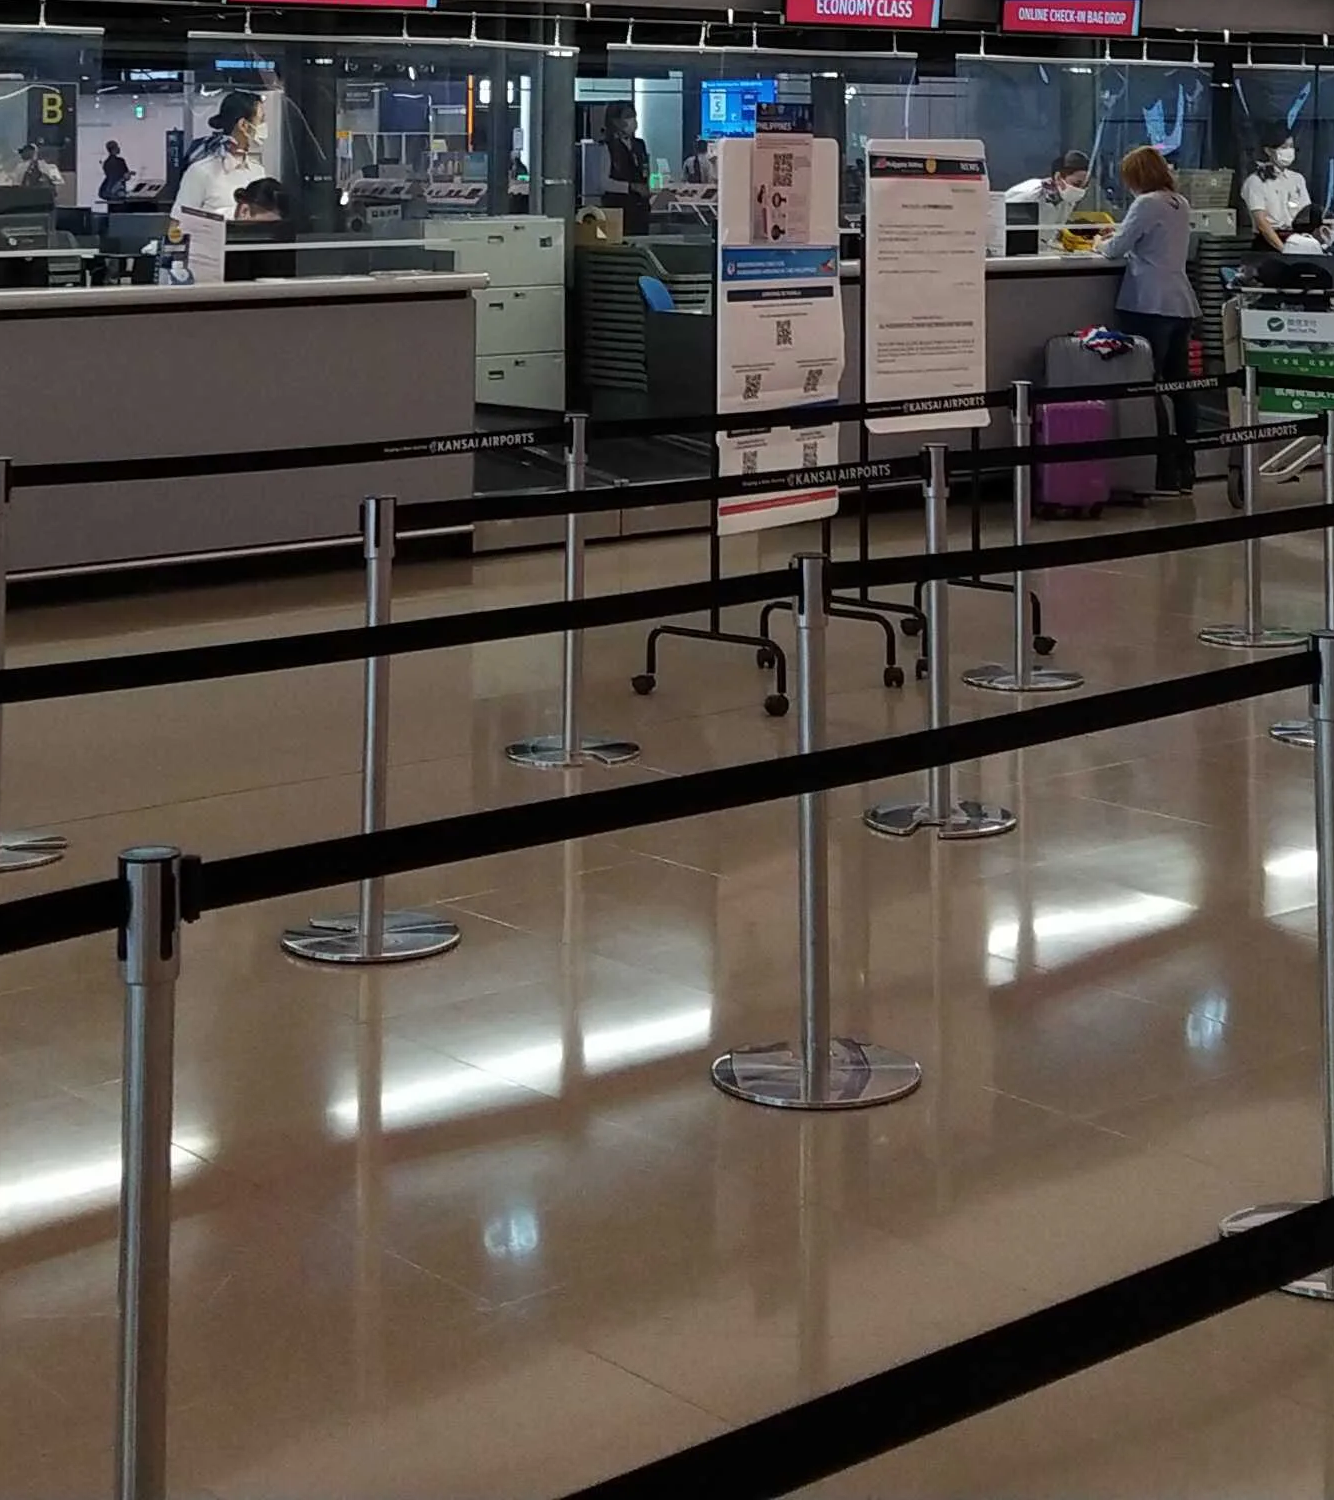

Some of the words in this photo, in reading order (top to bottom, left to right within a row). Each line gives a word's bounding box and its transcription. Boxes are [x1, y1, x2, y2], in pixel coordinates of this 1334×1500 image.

[877, 0, 913, 18] CLASS
[1018, 7, 1049, 21] ONLINE
[1050, 8, 1087, 23] CHECK-IN
[1087, 10, 1104, 24] BAG
[1104, 11, 1127, 25] DROP
[42, 93, 63, 124] B
[909, 400, 942, 412] KANSAI
[943, 396, 986, 409] AIRPORTS
[437, 439, 479, 451] KANSAI
[481, 433, 535, 448] AIRPORTS
[1224, 430, 1257, 444] KANSAI
[1258, 424, 1298, 439] AIRPORTS
[795, 468, 837, 486] KANSAI
[839, 464, 891, 482] AIRPORTS
